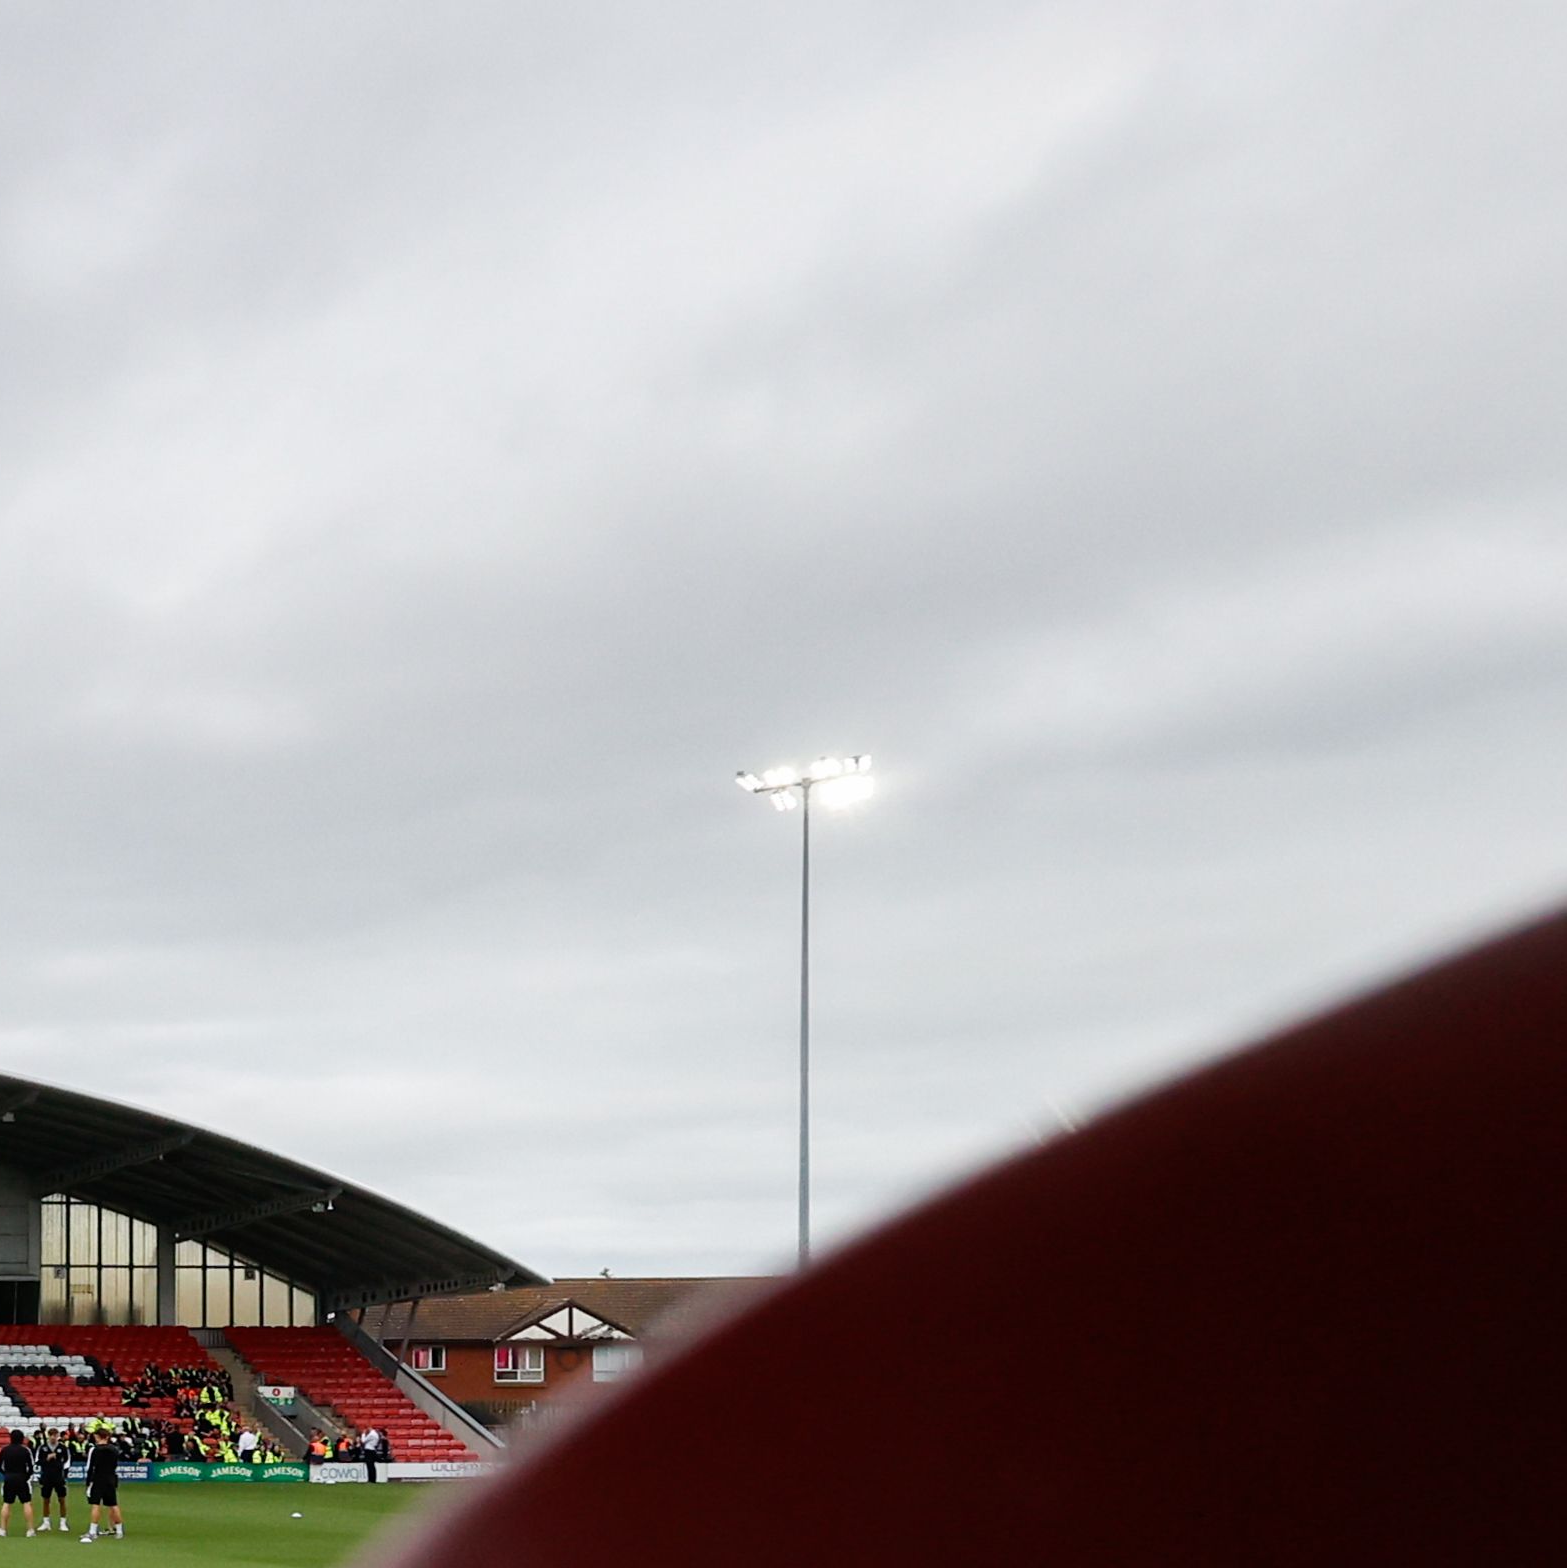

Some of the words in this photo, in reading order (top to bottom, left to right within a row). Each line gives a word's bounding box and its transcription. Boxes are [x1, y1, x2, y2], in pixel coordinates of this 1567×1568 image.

[159, 1465, 202, 1478] JAMESON
[210, 1466, 254, 1478] JAMESON
[262, 1466, 306, 1479] JAMESON
